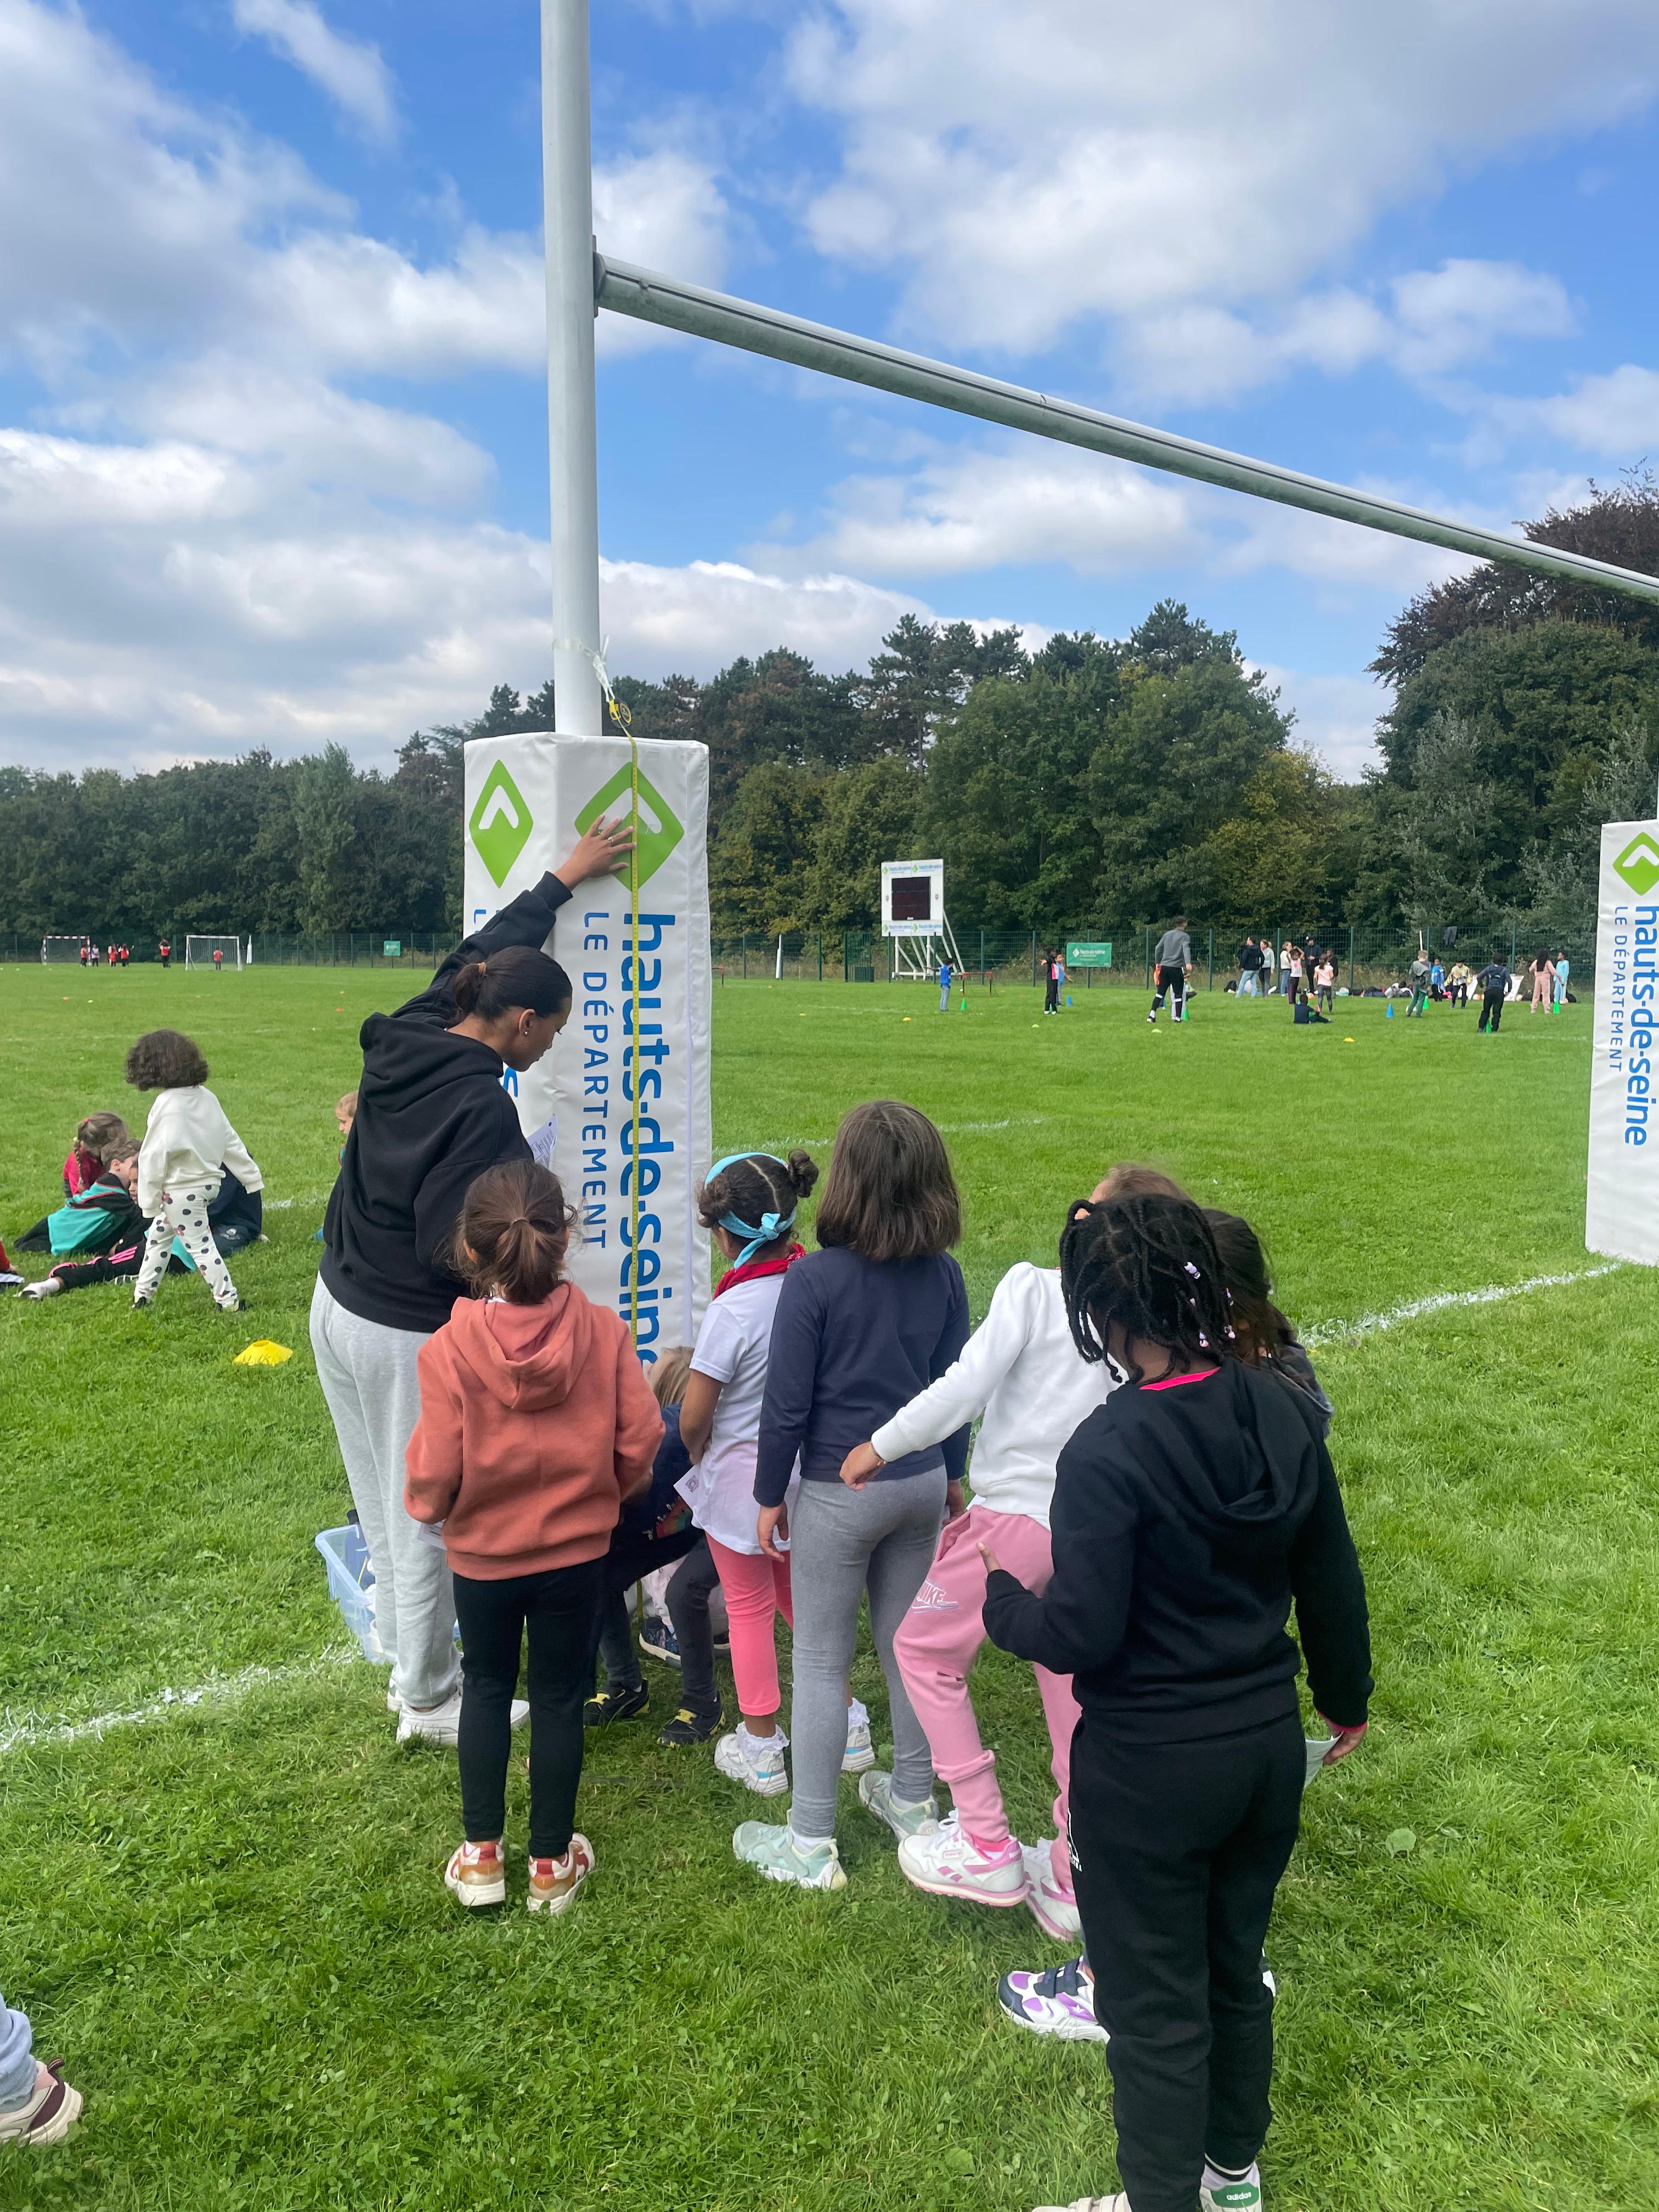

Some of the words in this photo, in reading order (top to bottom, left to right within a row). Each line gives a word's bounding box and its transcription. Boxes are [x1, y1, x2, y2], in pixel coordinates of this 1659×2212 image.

[584, 912, 610, 951] LE
[1615, 906, 1628, 925] LE
[1609, 935, 1630, 1072] DÉPARTEMENT
[582, 972, 614, 1249] DÉPARTEMENT
[1226, 2192, 1252, 2200] adidas
